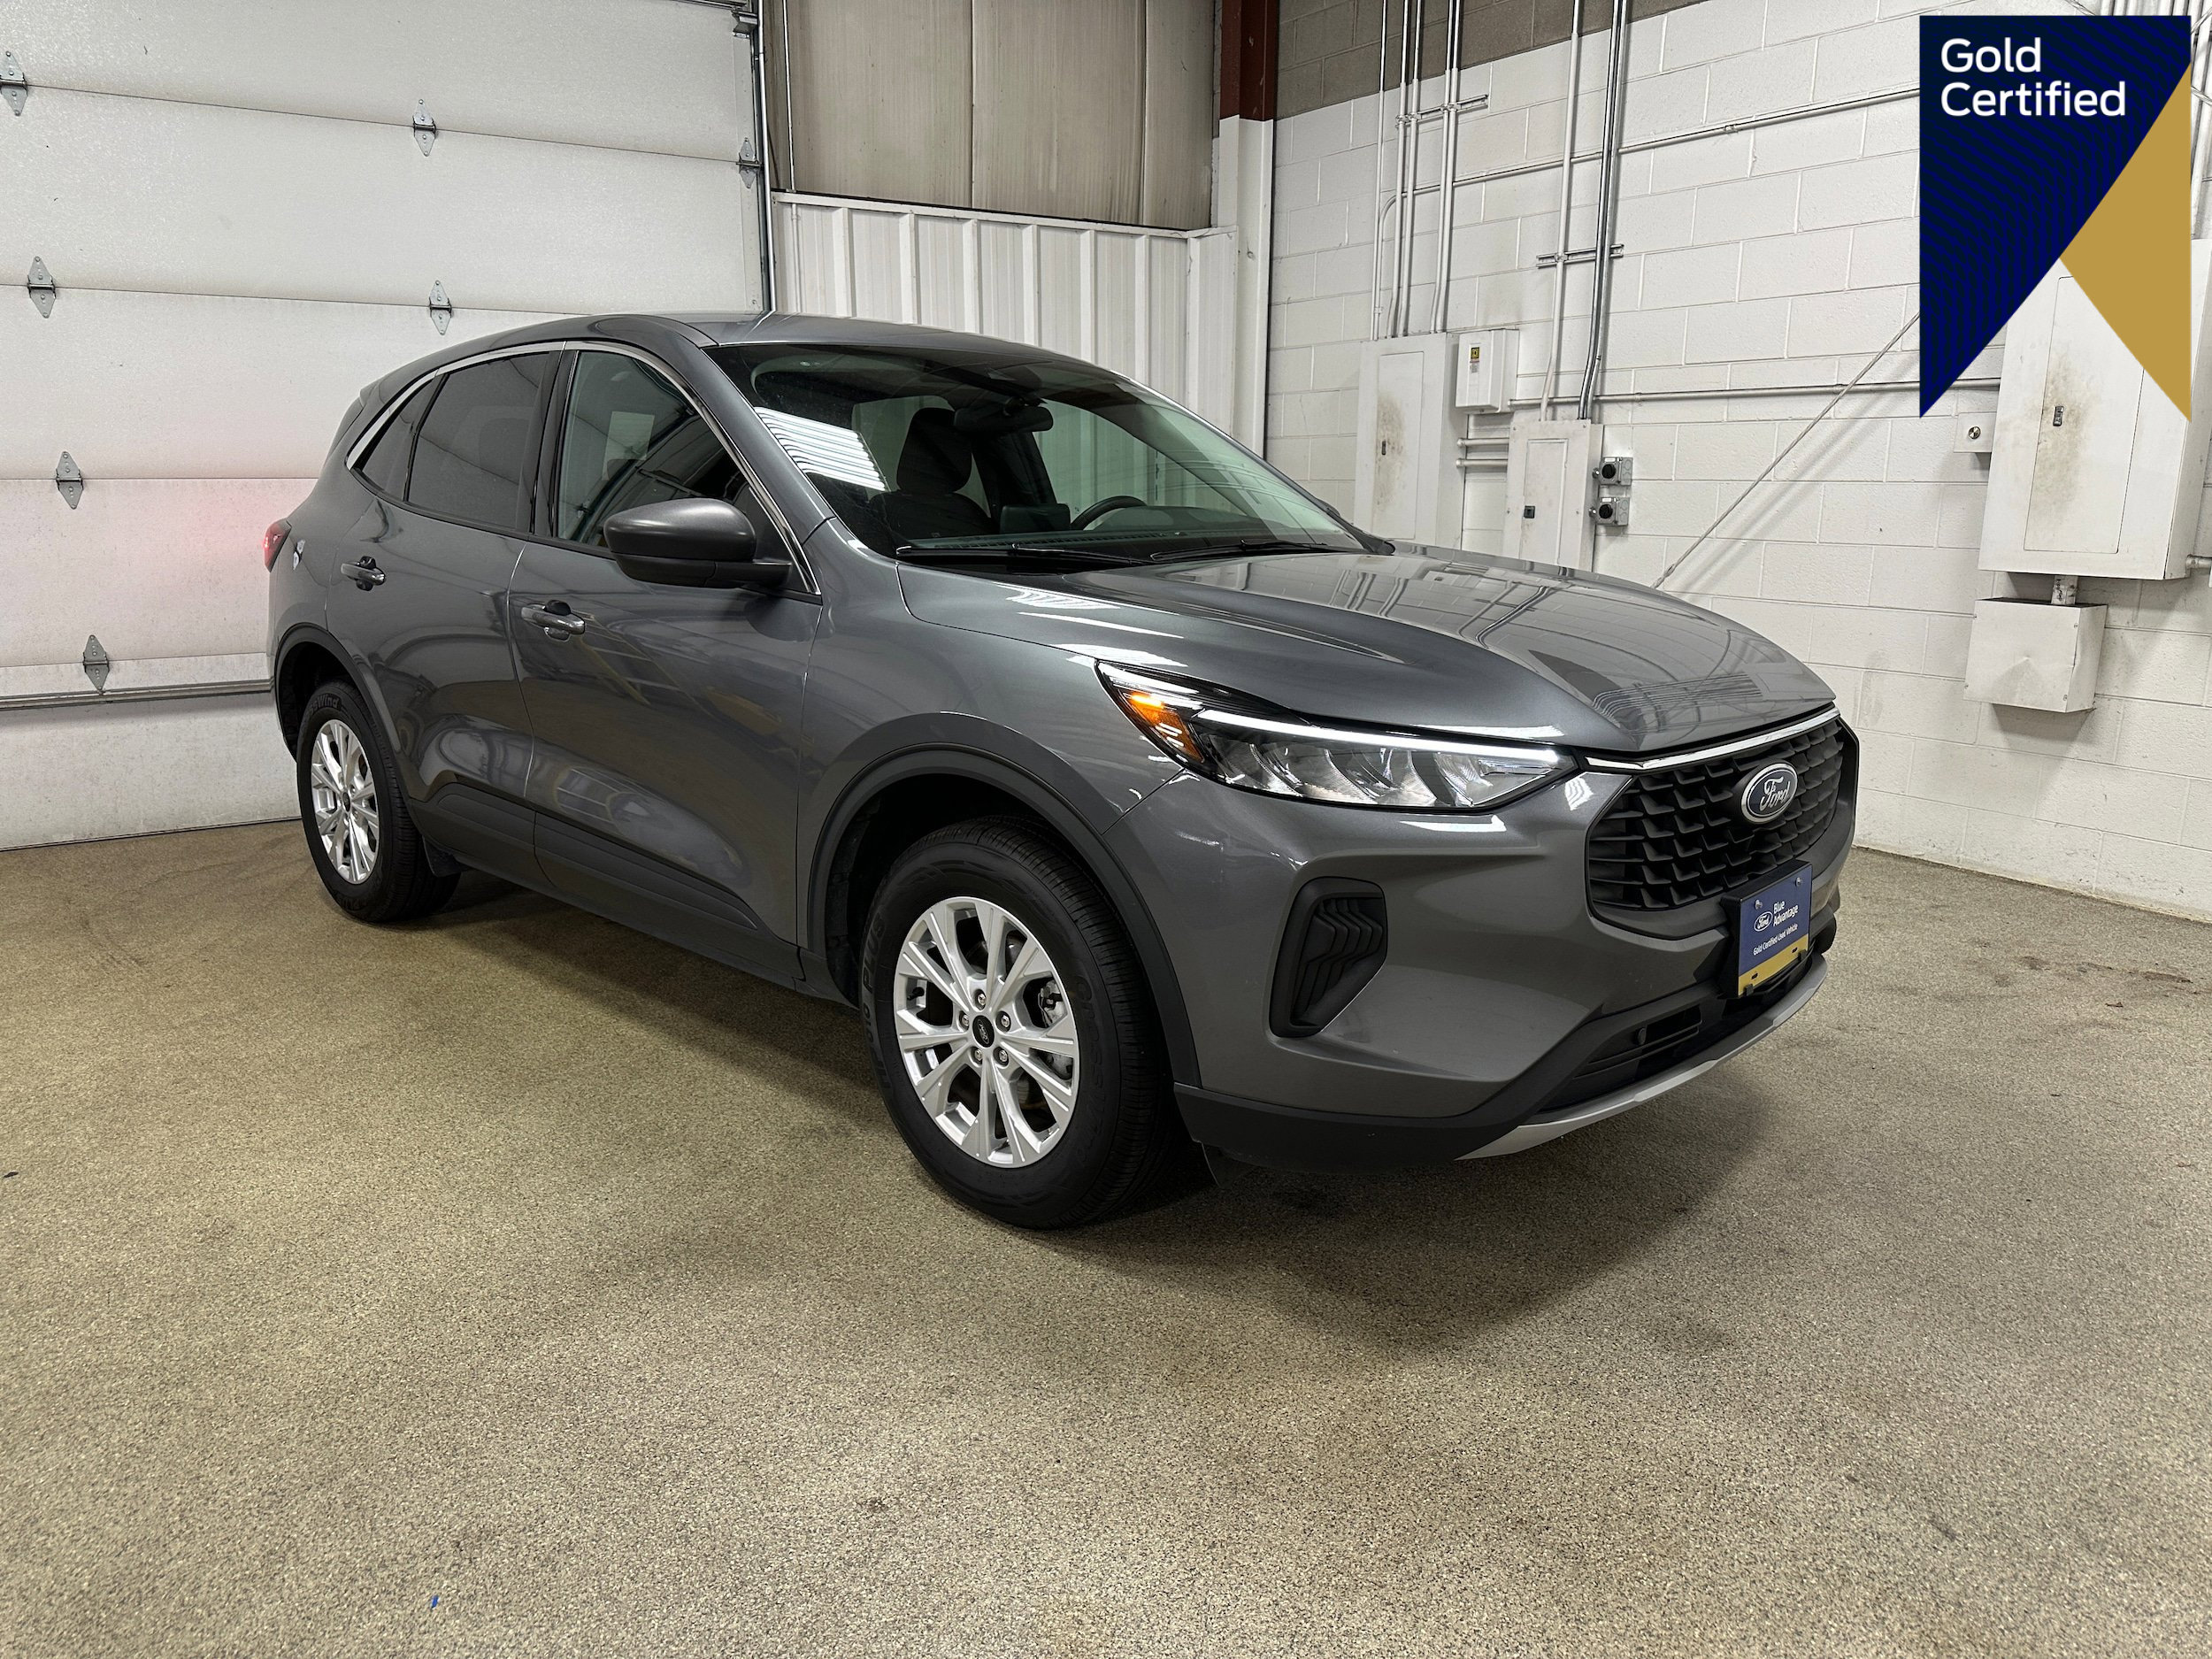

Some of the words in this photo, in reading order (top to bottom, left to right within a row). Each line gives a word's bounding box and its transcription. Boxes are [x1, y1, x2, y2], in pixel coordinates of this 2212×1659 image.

[1760, 776, 1792, 811] Ford
[1773, 901, 1786, 914] Blue
[1773, 904, 1799, 927] Advantage
[1756, 914, 1770, 930] Ford
[1753, 945, 1763, 956] Gold
[1763, 935, 1778, 951] Certified
[1778, 929, 1787, 943] Used
[1786, 923, 1799, 937] Vehicle
